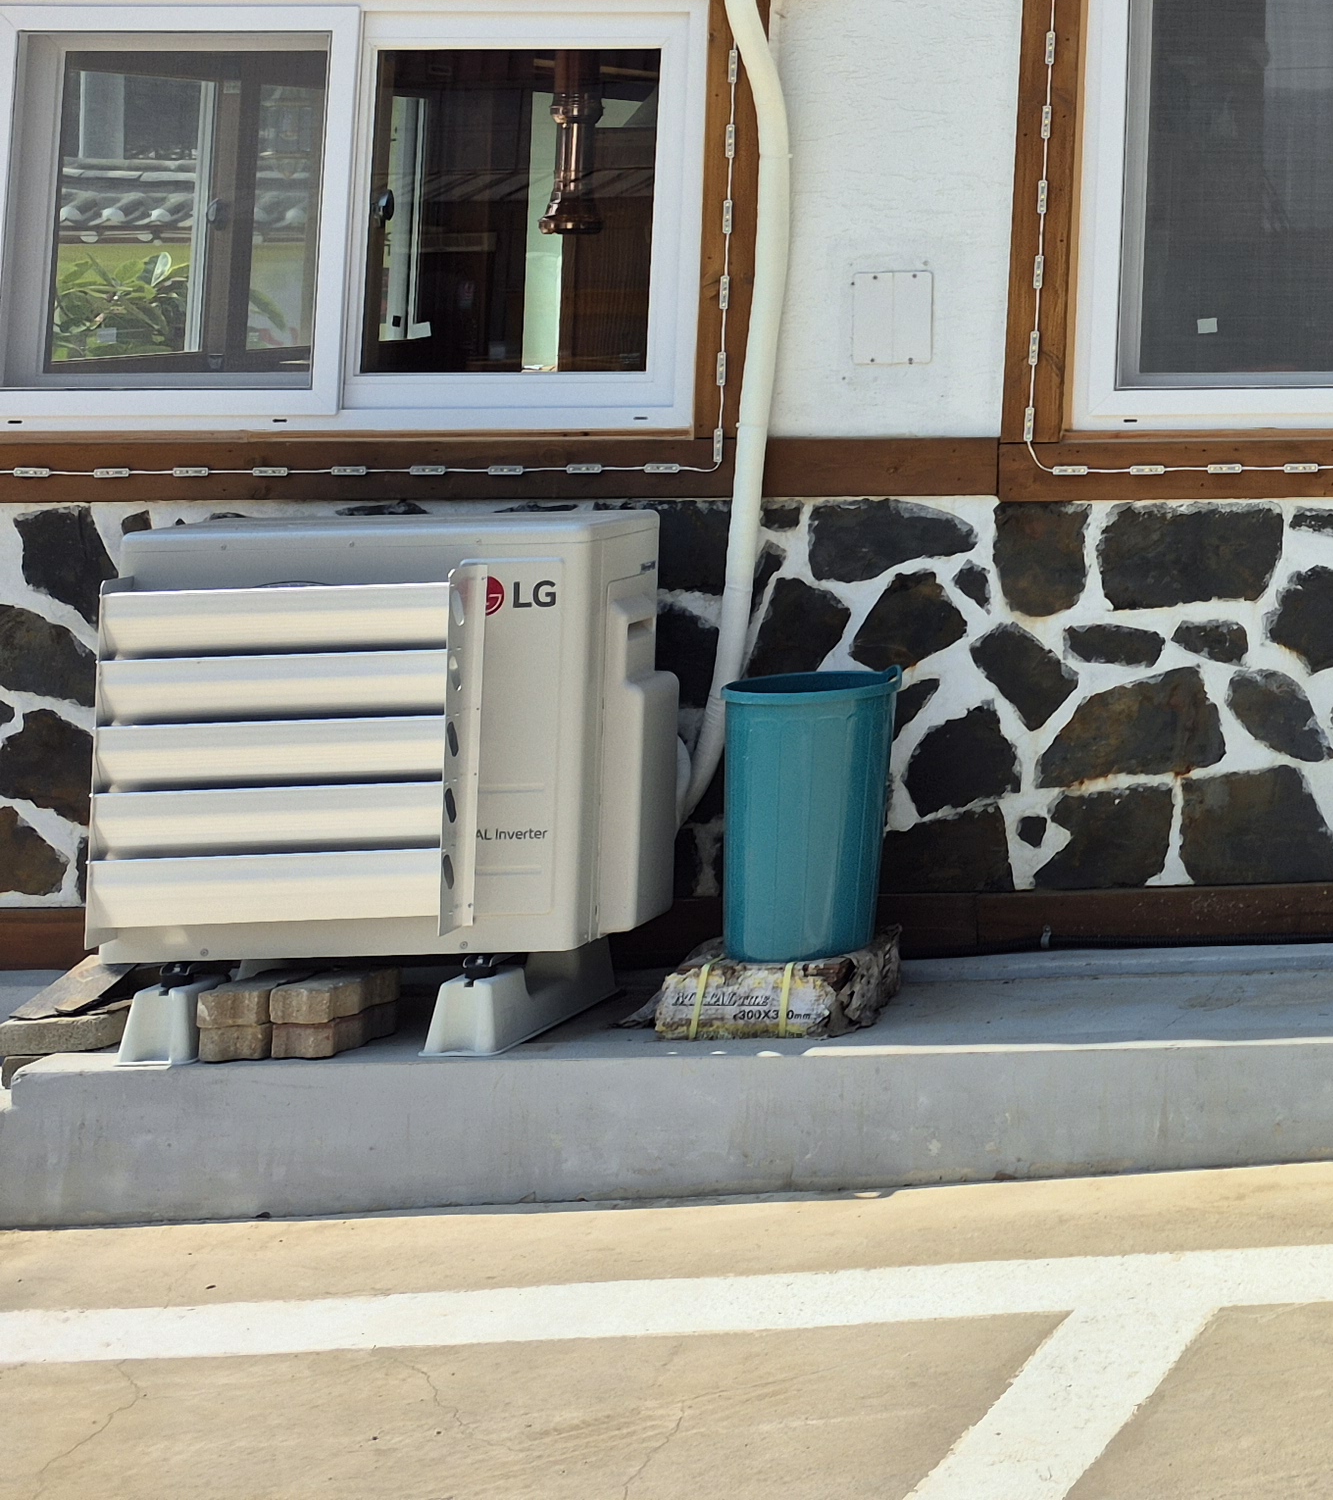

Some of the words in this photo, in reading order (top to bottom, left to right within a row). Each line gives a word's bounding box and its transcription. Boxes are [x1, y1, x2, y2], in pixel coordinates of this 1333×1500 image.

[512, 580, 557, 609] LG
[476, 828, 493, 841] AL
[495, 827, 549, 841] Inverter
[739, 1009, 811, 1021] 300X30mm
